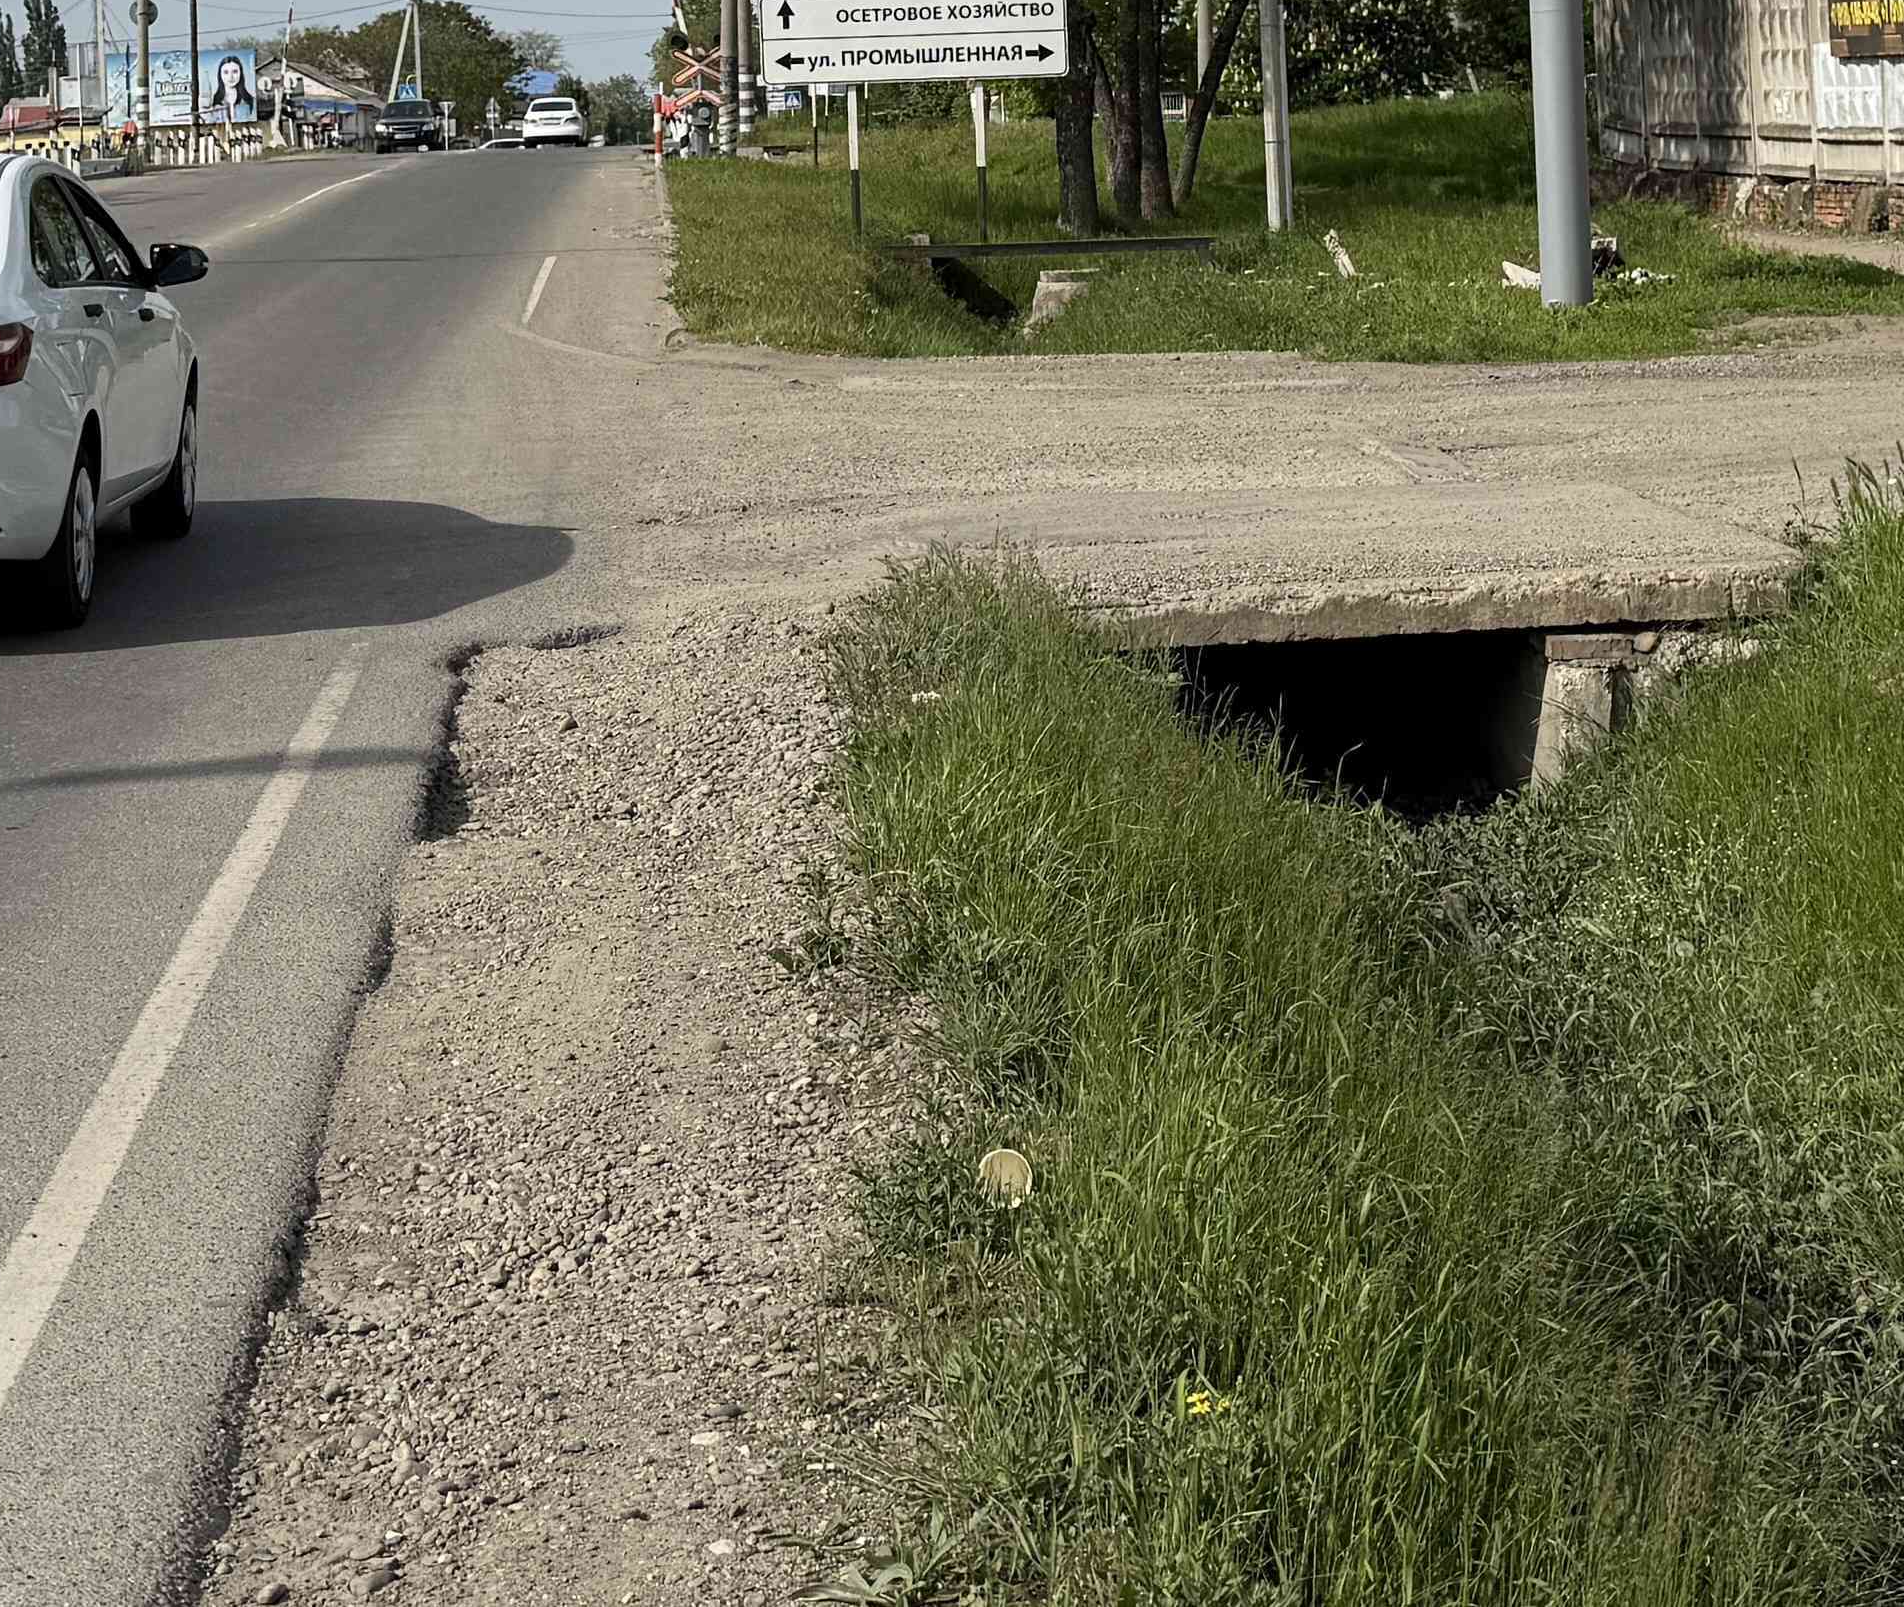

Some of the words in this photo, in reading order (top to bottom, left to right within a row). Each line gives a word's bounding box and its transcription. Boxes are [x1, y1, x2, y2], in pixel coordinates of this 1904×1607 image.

[836, 6, 943, 24] ОСЕТРОВОЕ
[947, 0, 1055, 21] ХОЗЯЙСТВО
[807, 54, 837, 73] ул.
[841, 44, 1024, 68] ПРОМЫШЛЕННАЯ
